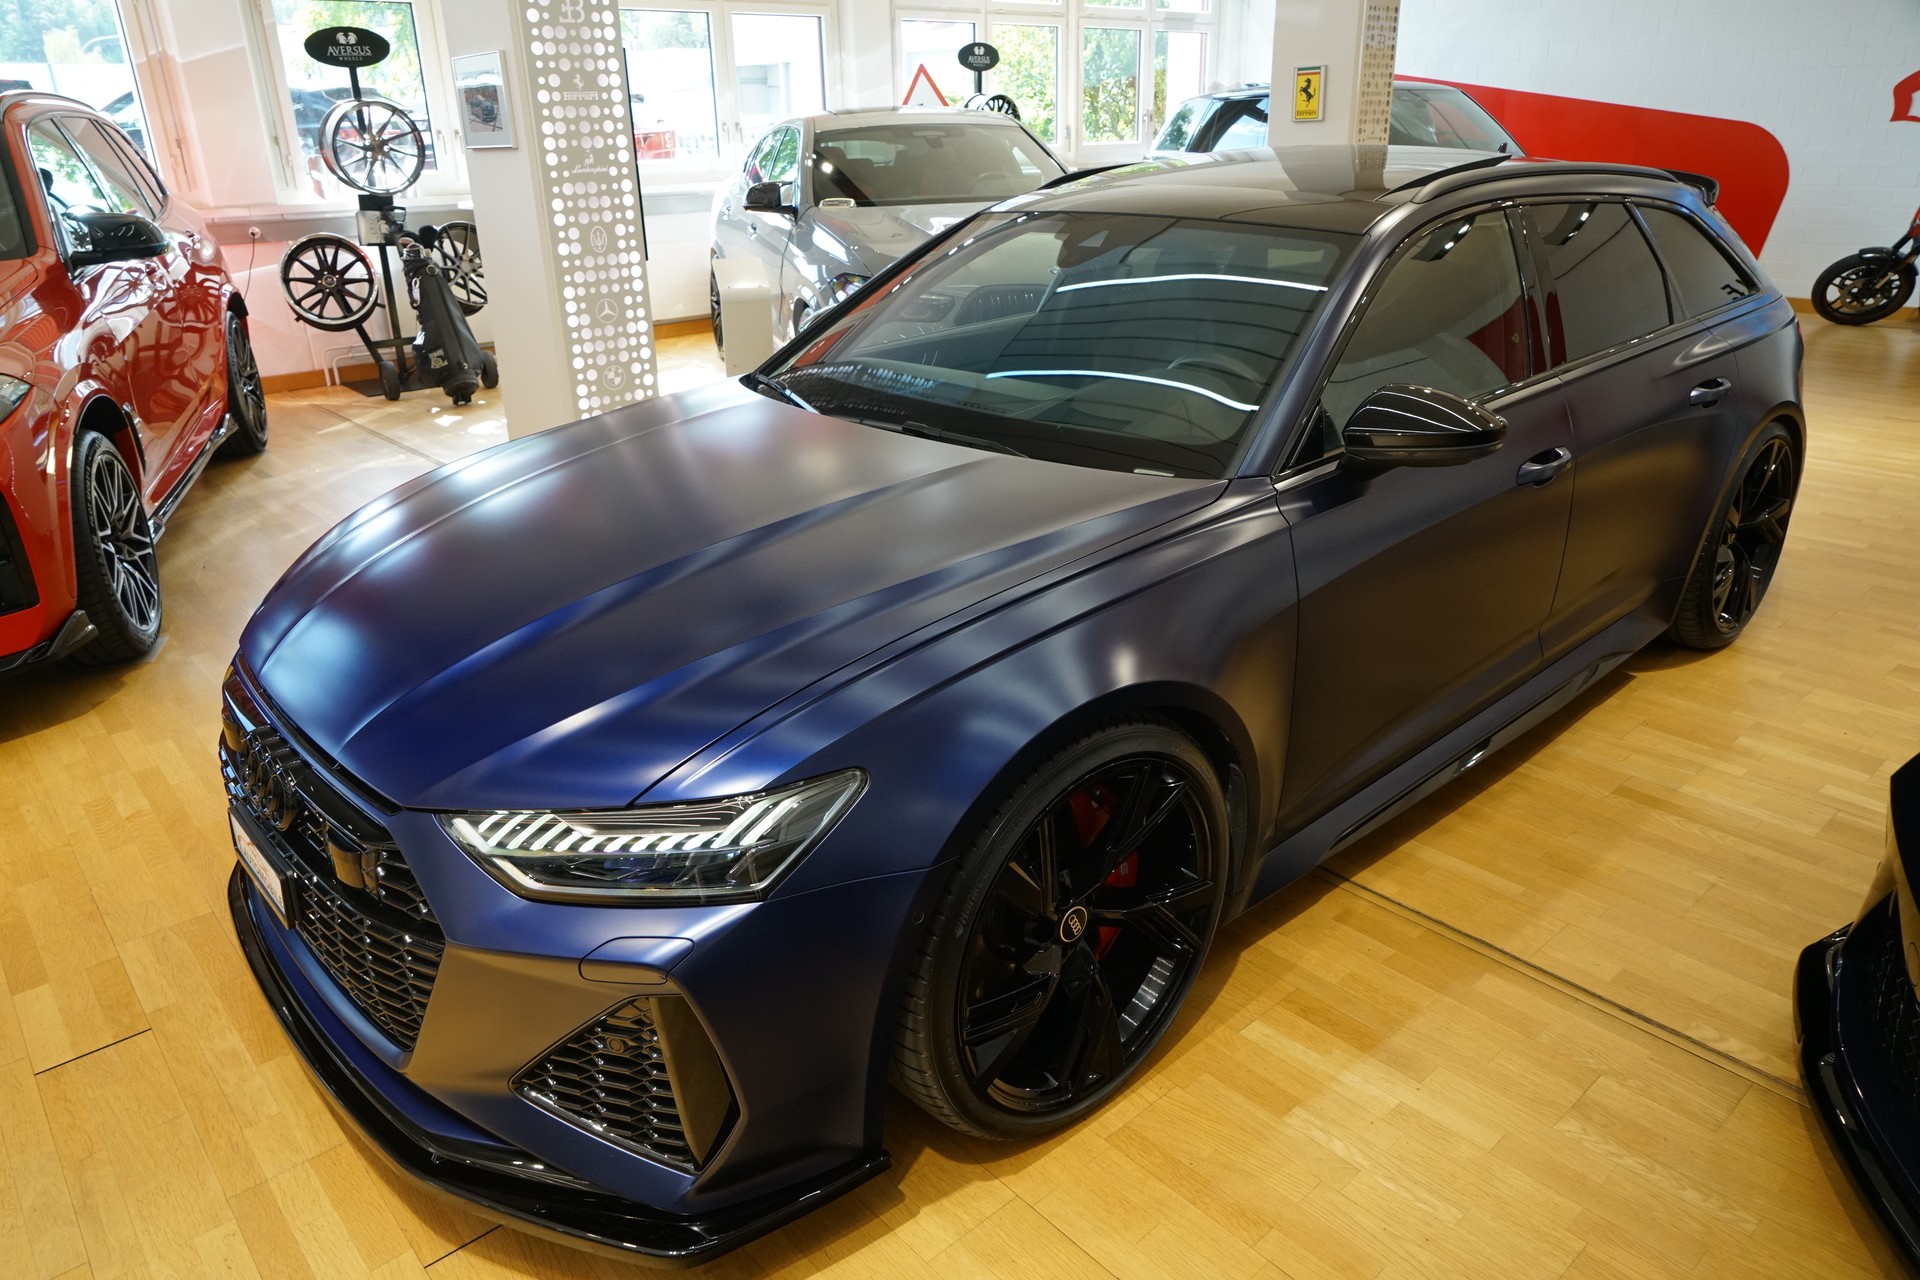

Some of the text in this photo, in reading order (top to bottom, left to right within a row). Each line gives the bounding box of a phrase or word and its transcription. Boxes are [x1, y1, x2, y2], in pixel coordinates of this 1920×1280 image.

[327, 45, 373, 57] AVERSUS
[967, 55, 990, 64] AVERSUS
[563, 91, 599, 101] Ferrari
